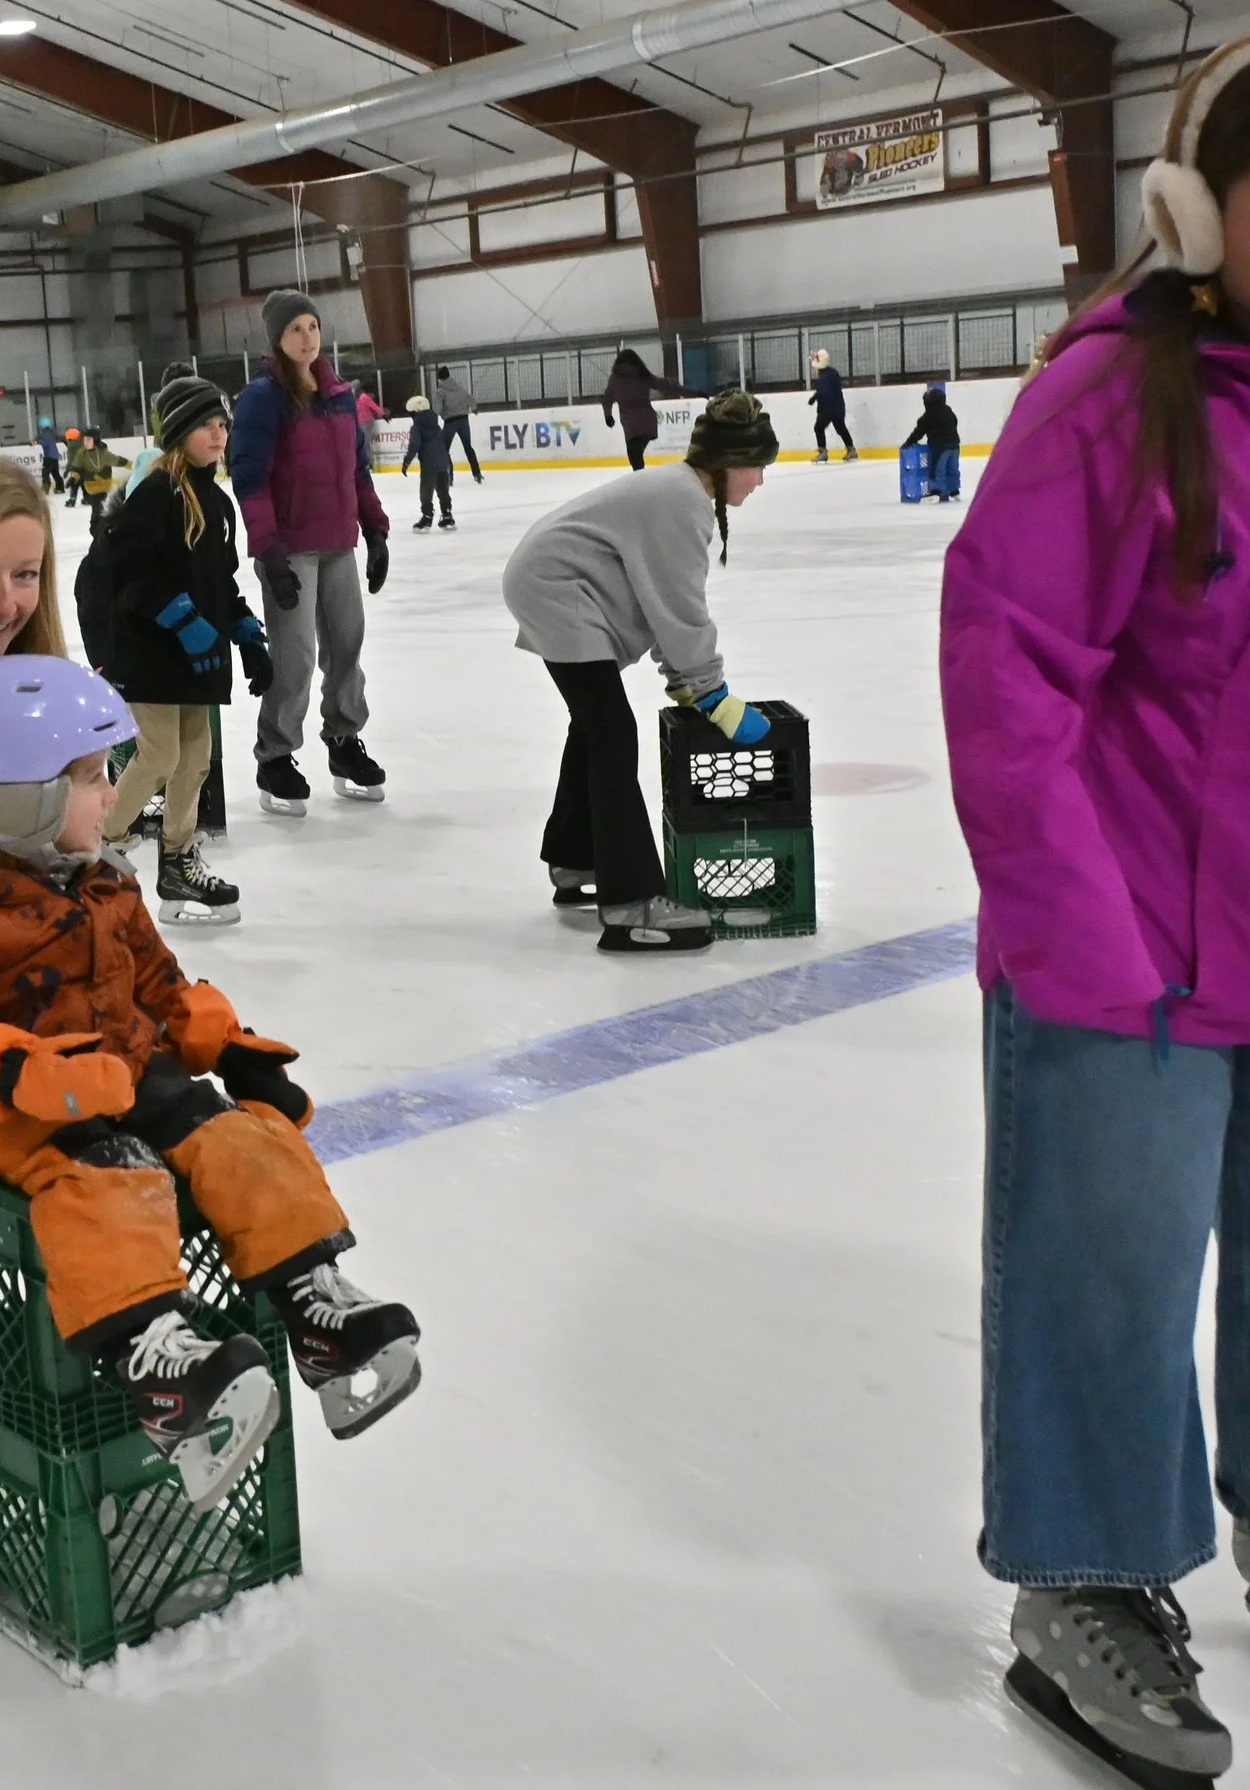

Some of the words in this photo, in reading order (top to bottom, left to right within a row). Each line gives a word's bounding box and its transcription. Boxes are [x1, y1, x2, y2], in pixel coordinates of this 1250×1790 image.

[868, 170, 893, 183] SLED
[895, 153, 938, 173] HOCKEY
[666, 410, 691, 425] NFP
[490, 423, 528, 450] FLY
[535, 420, 581, 448] BTV
[152, 1397, 175, 1408] CCM
